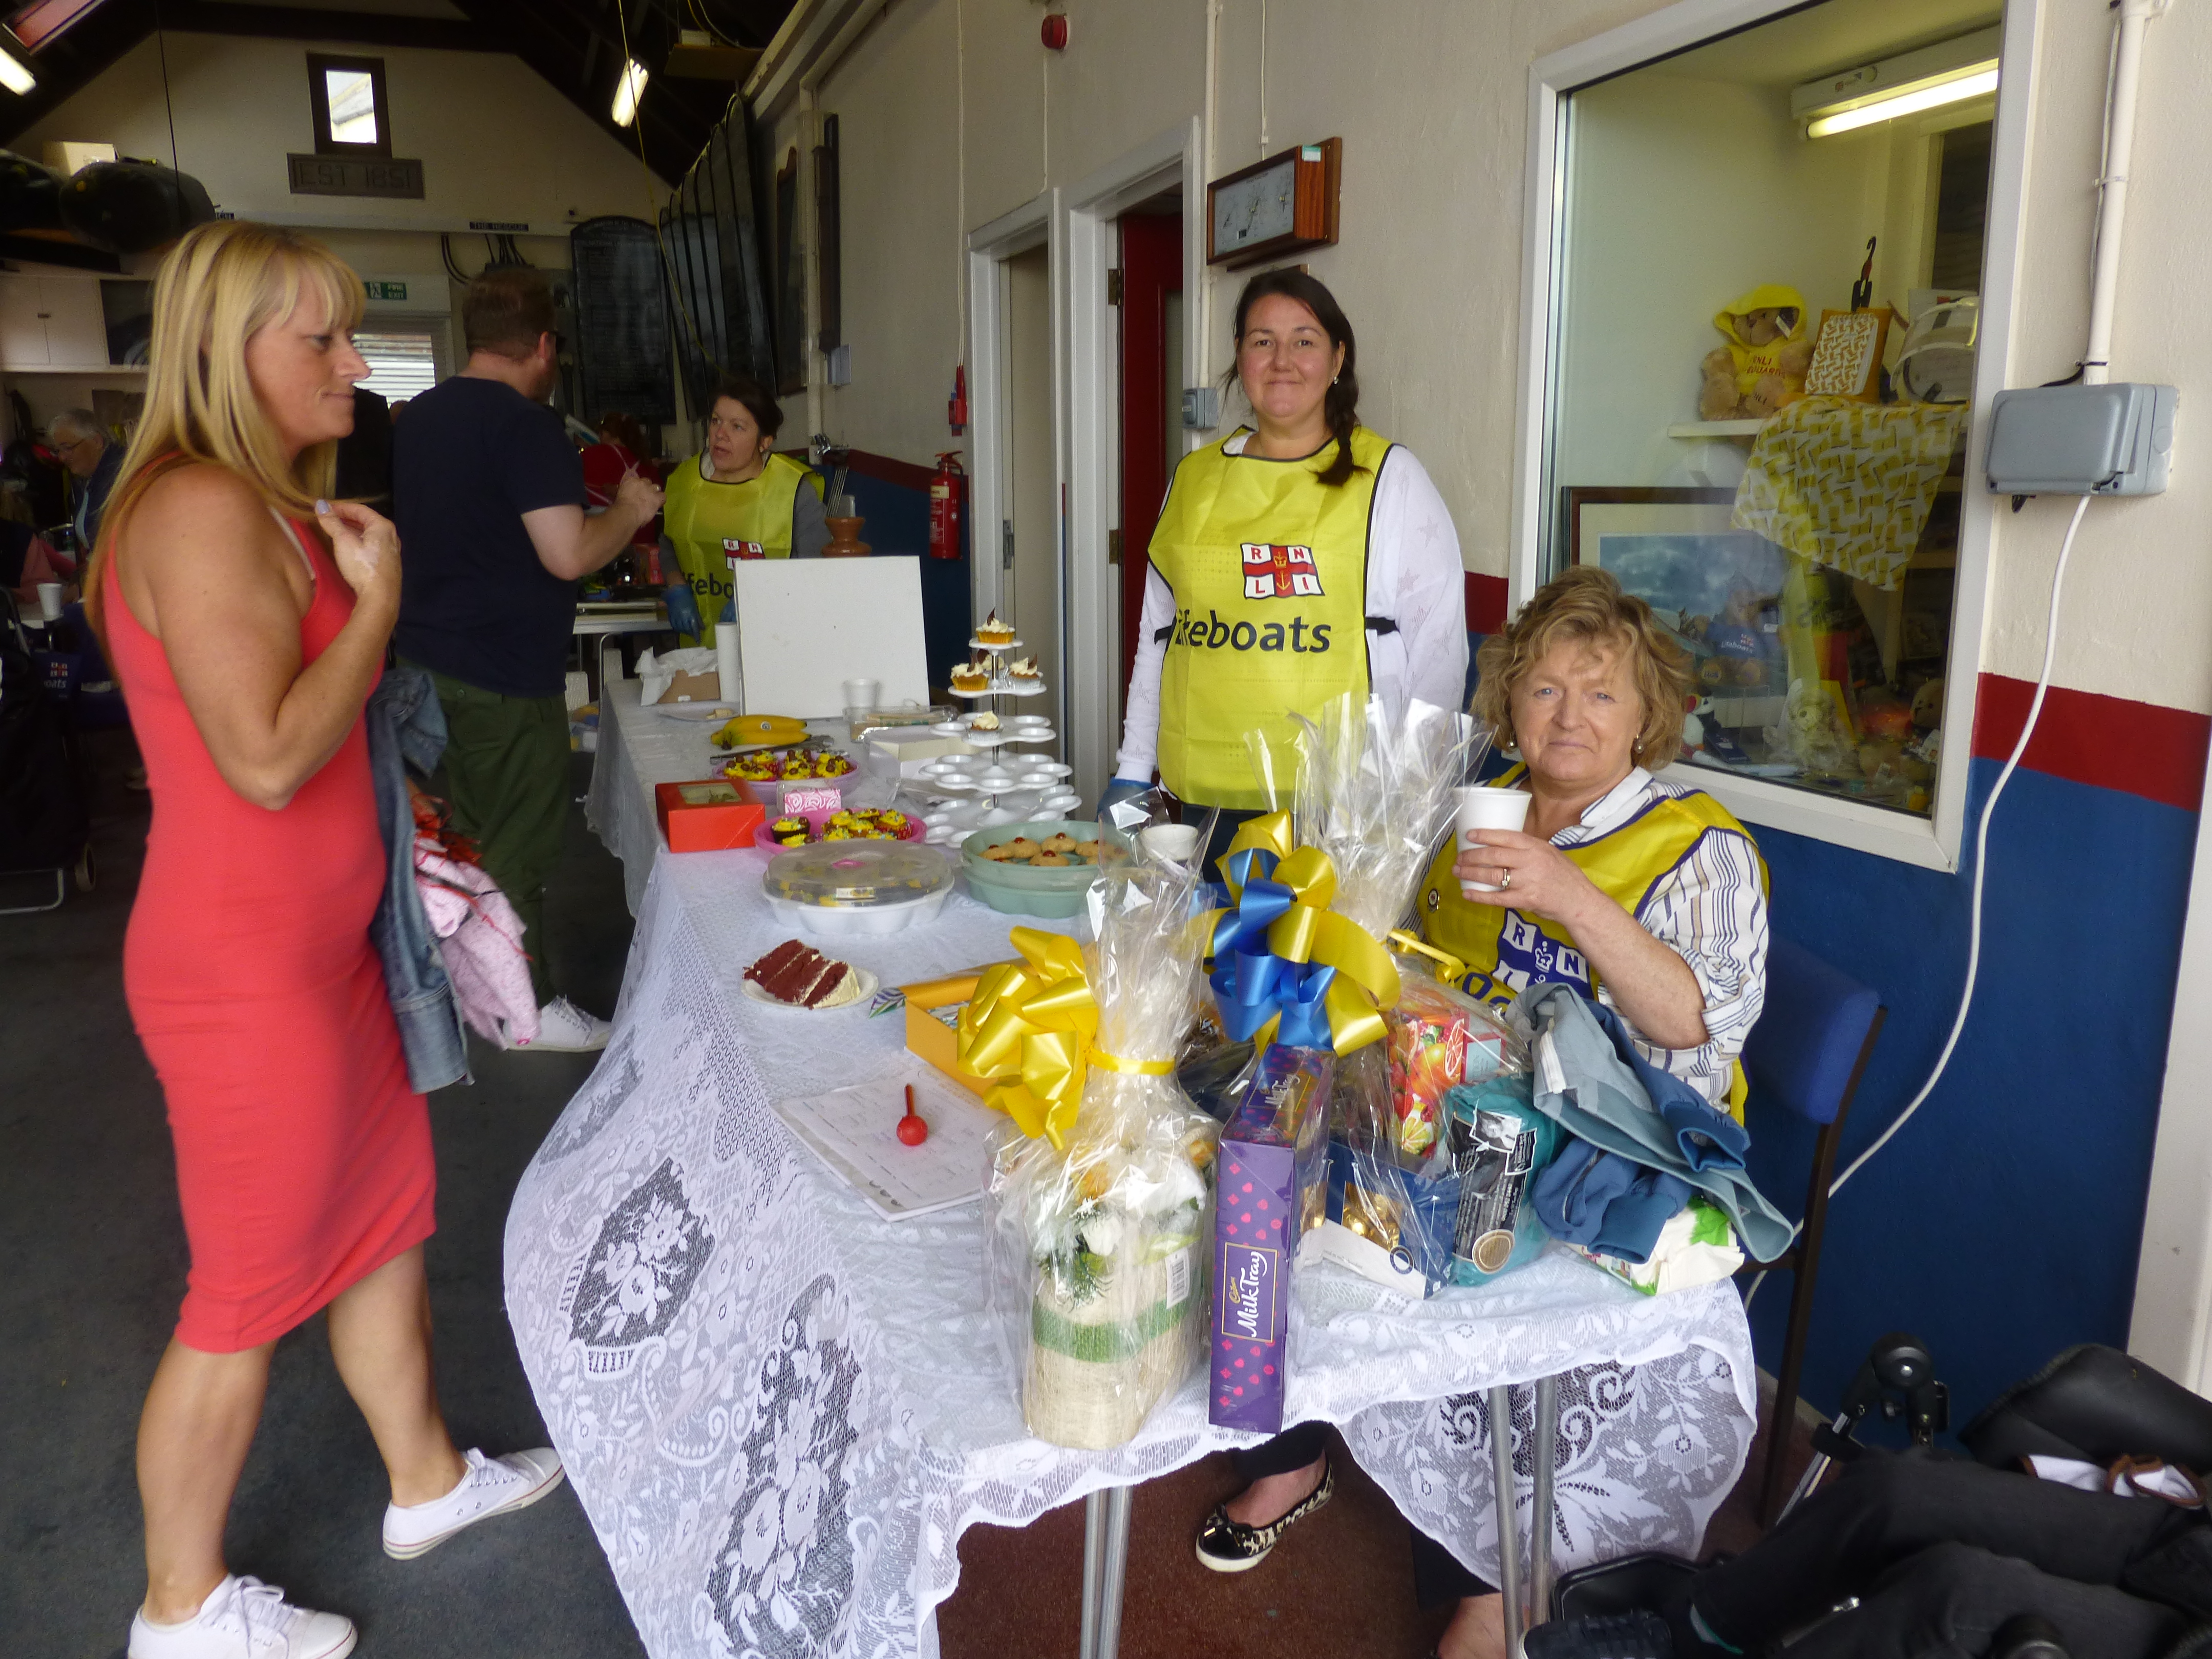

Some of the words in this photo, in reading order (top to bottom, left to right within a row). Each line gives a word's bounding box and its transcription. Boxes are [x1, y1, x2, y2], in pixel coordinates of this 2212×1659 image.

[300, 163, 347, 186] EST
[1239, 1251, 1268, 1291] Tray
[1237, 1286, 1260, 1338] Milk
